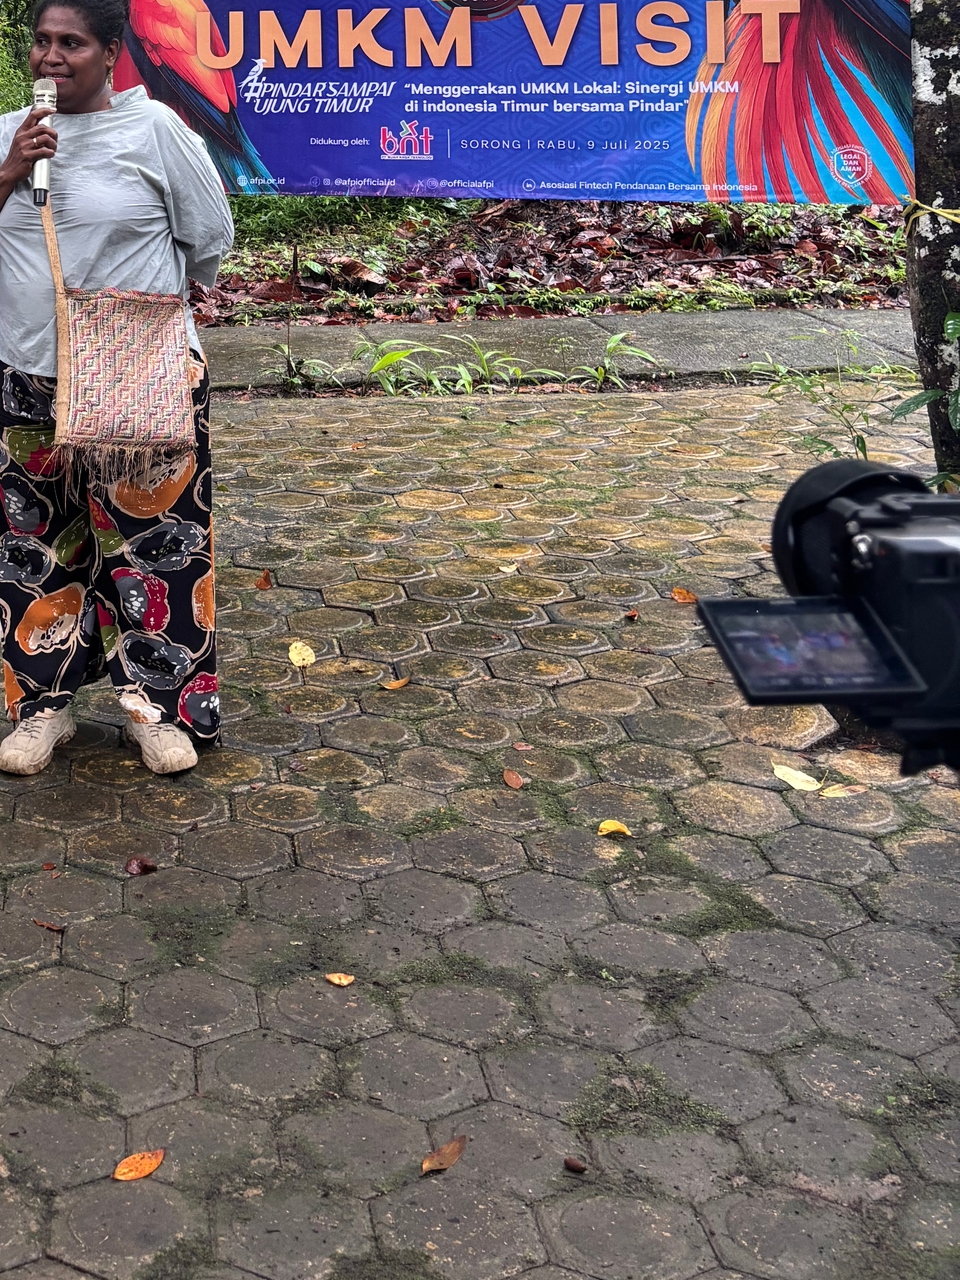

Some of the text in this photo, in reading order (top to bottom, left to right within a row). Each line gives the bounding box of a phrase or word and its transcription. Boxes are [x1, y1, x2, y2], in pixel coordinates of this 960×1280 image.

[195, 6, 472, 70] UMKM
[327, 82, 396, 97] SAMPAI
[521, 82, 569, 94] UMKM
[574, 82, 620, 94] Lokal:
[625, 81, 683, 96] Sinergi
[689, 81, 739, 93] UMKM
[254, 98, 374, 115] UJUNG TIMUR
[405, 100, 418, 112] di
[423, 100, 497, 112] indonesia
[501, 100, 548, 112] Timur
[553, 100, 624, 112] bersama
[310, 138, 348, 146] Didukung
[460, 140, 521, 149] SORONG
[588, 141, 594, 150] 9
[602, 140, 627, 150] Juli
[634, 141, 670, 150] 2025
[250, 177, 285, 186] afpi.or.id
[440, 179, 494, 189] @officialafpi
[540, 181, 577, 189] Asosiasi
[615, 182, 666, 190] Pendanaan
[713, 183, 757, 191] Indonesia
